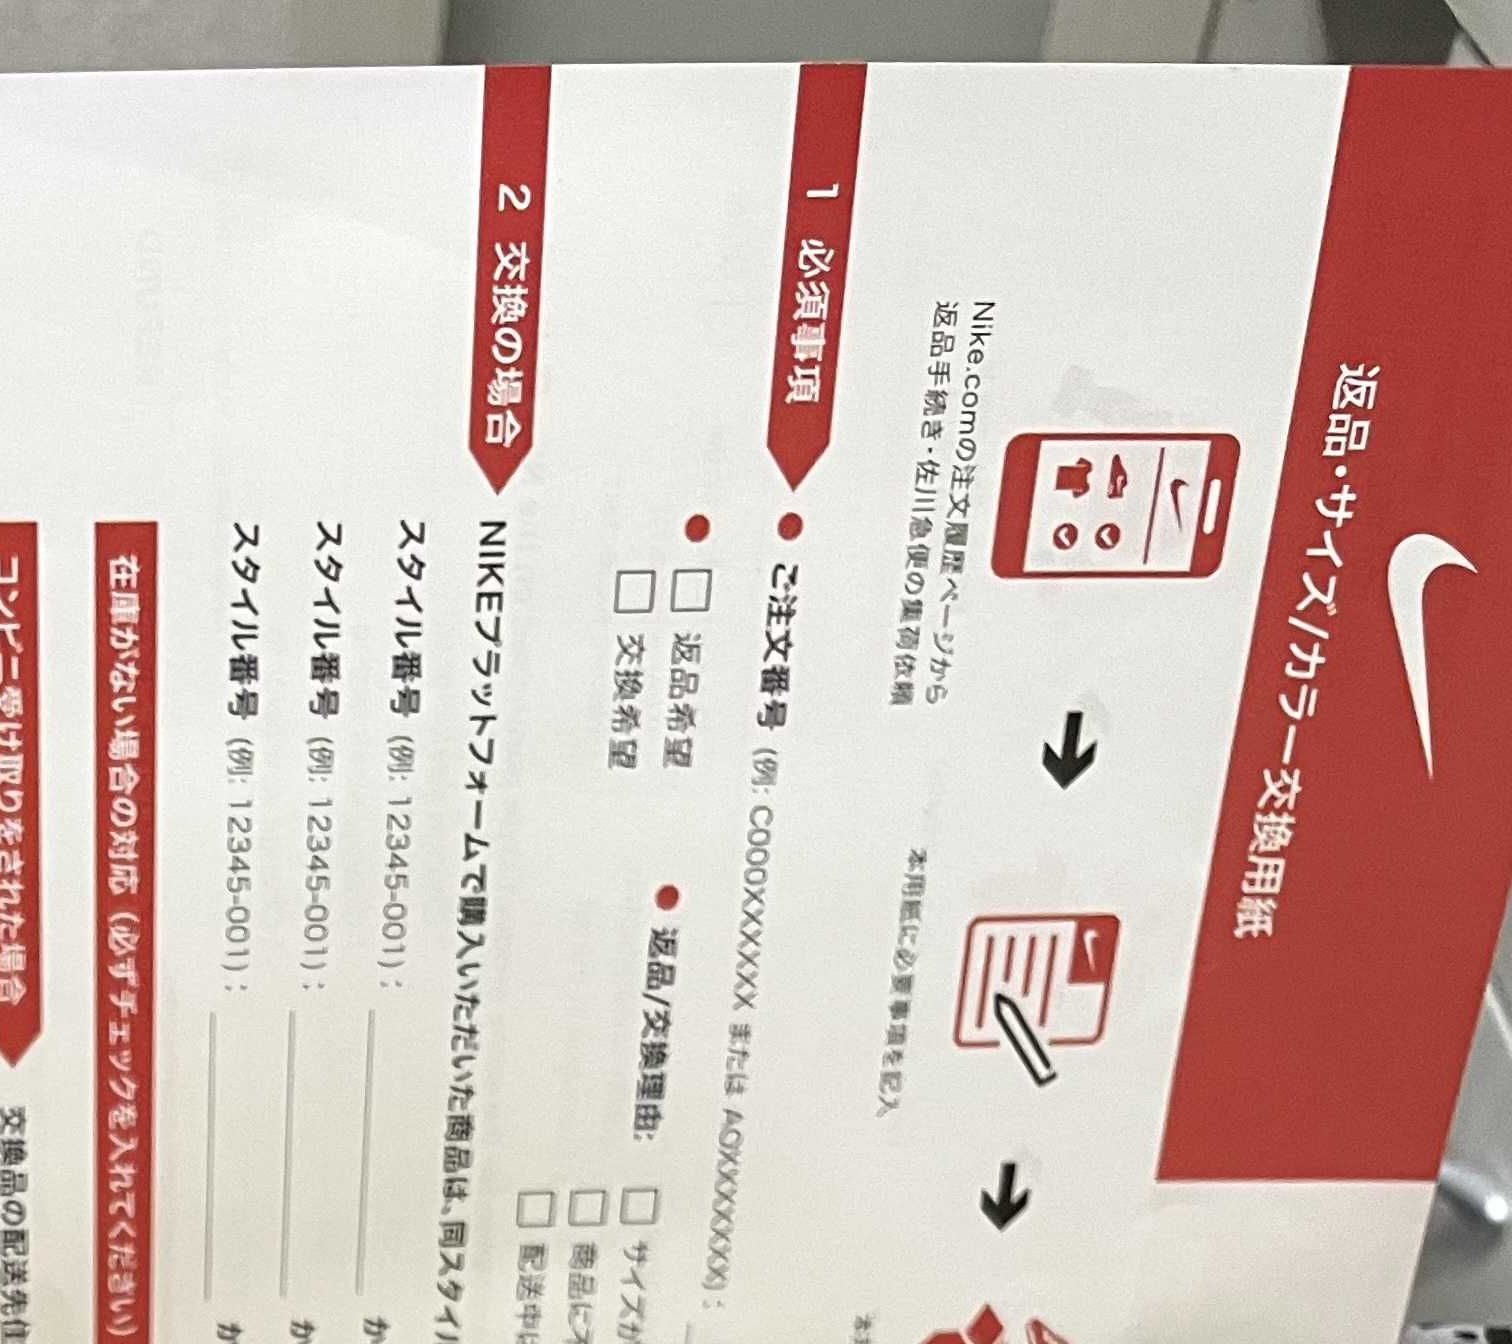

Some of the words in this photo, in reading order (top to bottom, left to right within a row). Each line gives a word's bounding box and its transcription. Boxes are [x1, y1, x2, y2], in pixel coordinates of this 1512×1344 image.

[497, 183, 531, 211] 2
[806, 183, 838, 201] 1
[486, 241, 530, 449] 交換の場合
[784, 239, 834, 405] 必須事項
[924, 301, 996, 706] Nike.comの注文履歴ページから
[227, 523, 260, 721] スタイル番号
[309, 521, 343, 720] スタイル番号
[391, 520, 427, 718] スタイル番号
[608, 633, 647, 770] 交換希望
[663, 632, 702, 769] 返品希望
[756, 562, 800, 730] ご注文番号
[1232, 363, 1381, 940] 返品・サイズ/カラー交換用紙
[633, 926, 678, 1143] 返品/交換理由:
[723, 1023, 752, 1096] または
